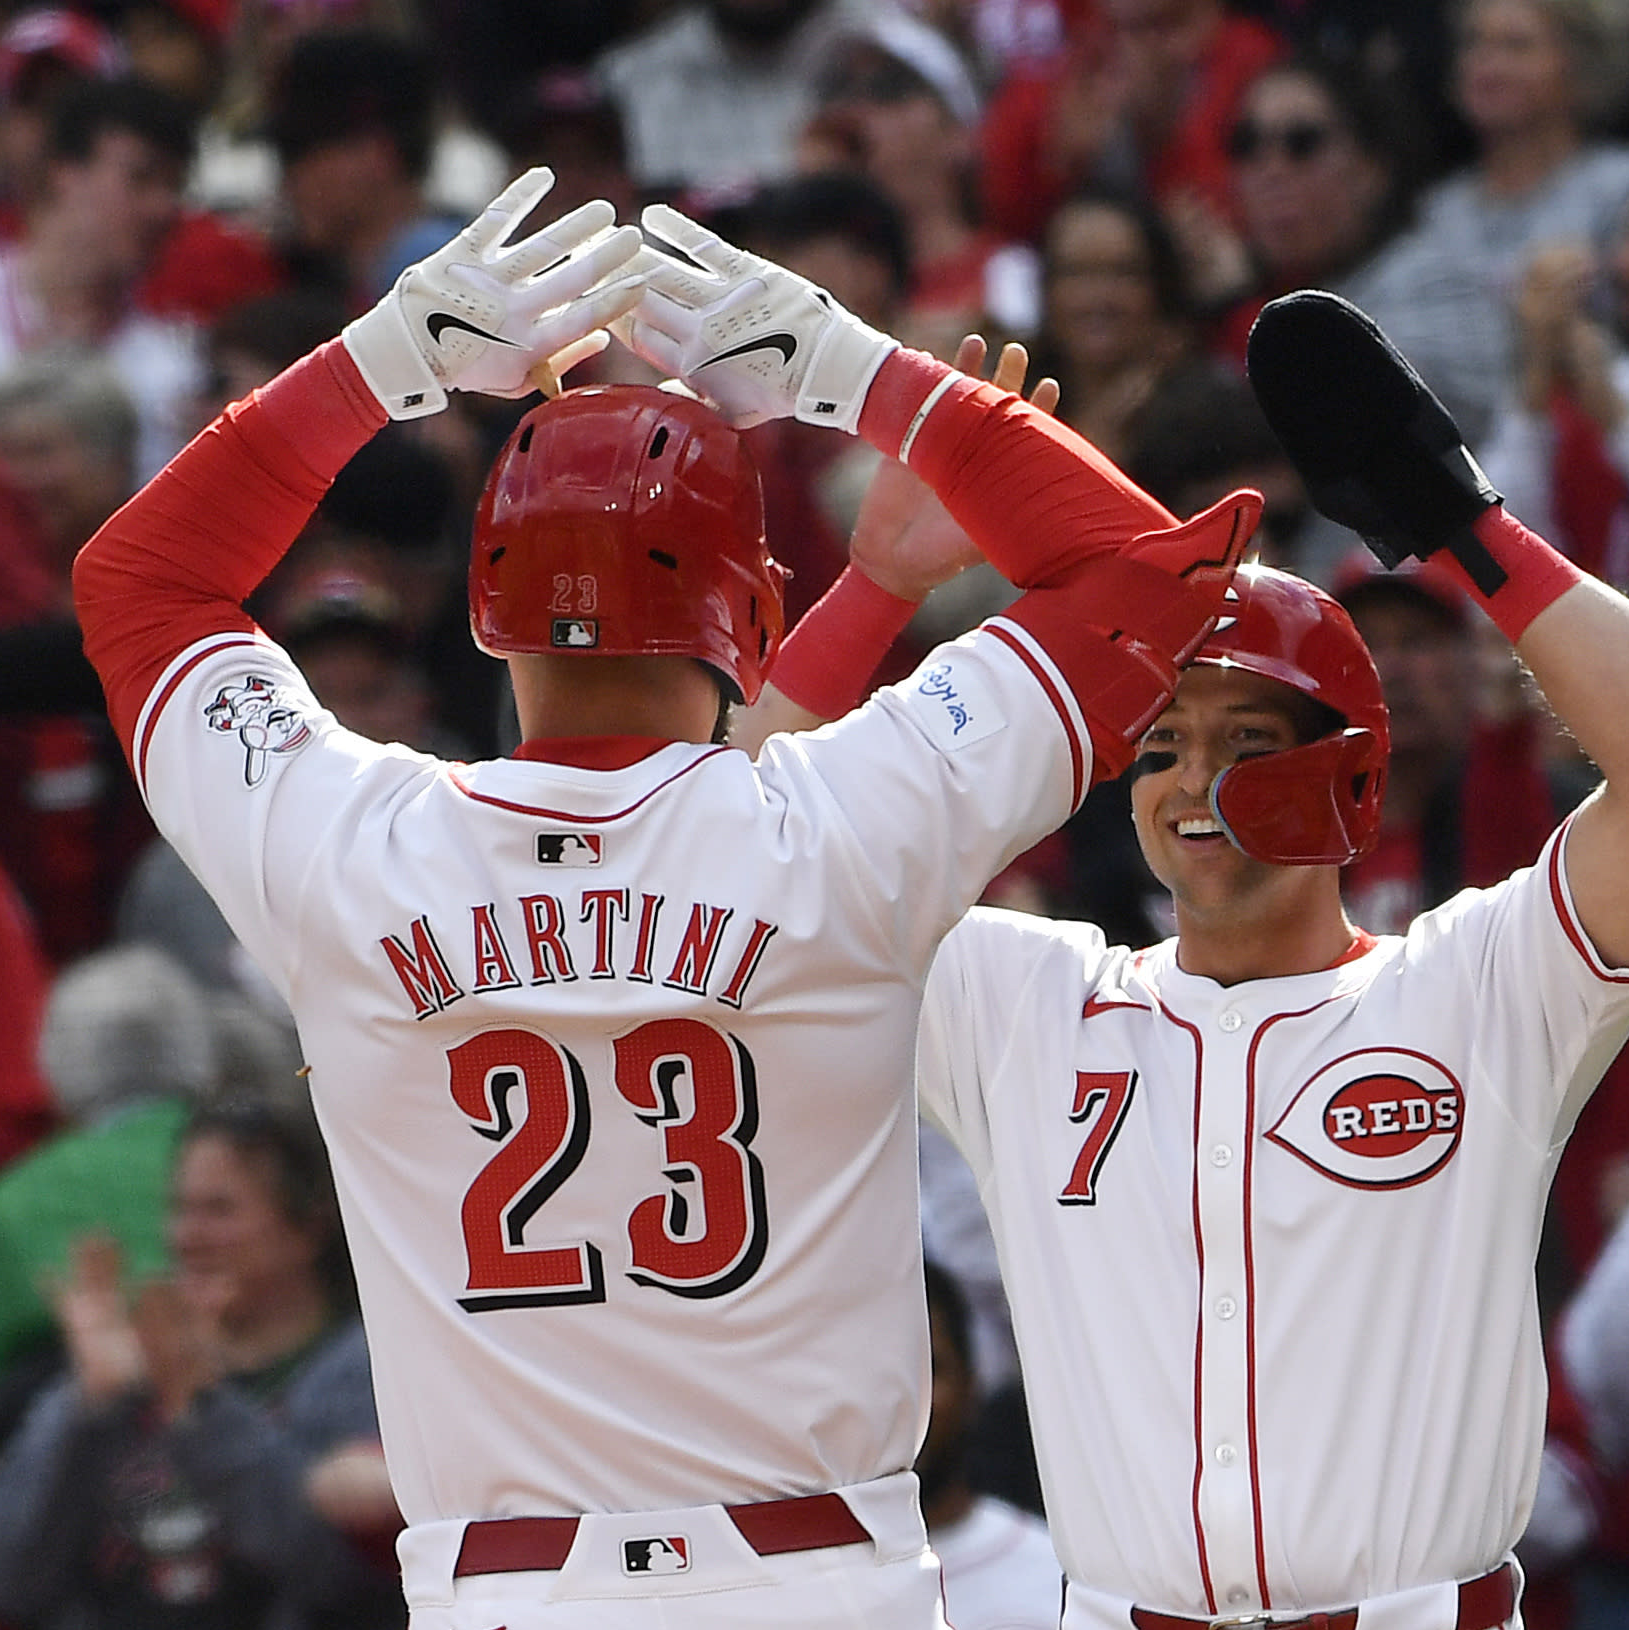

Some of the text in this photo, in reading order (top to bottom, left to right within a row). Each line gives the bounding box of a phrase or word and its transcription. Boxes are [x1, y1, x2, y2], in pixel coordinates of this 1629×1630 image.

[551, 572, 598, 614] 23
[379, 887, 779, 1022] MARTINI
[445, 1016, 771, 1315] 23
[1057, 1067, 1139, 1207] 7
[1328, 1095, 1459, 1140] REDS
